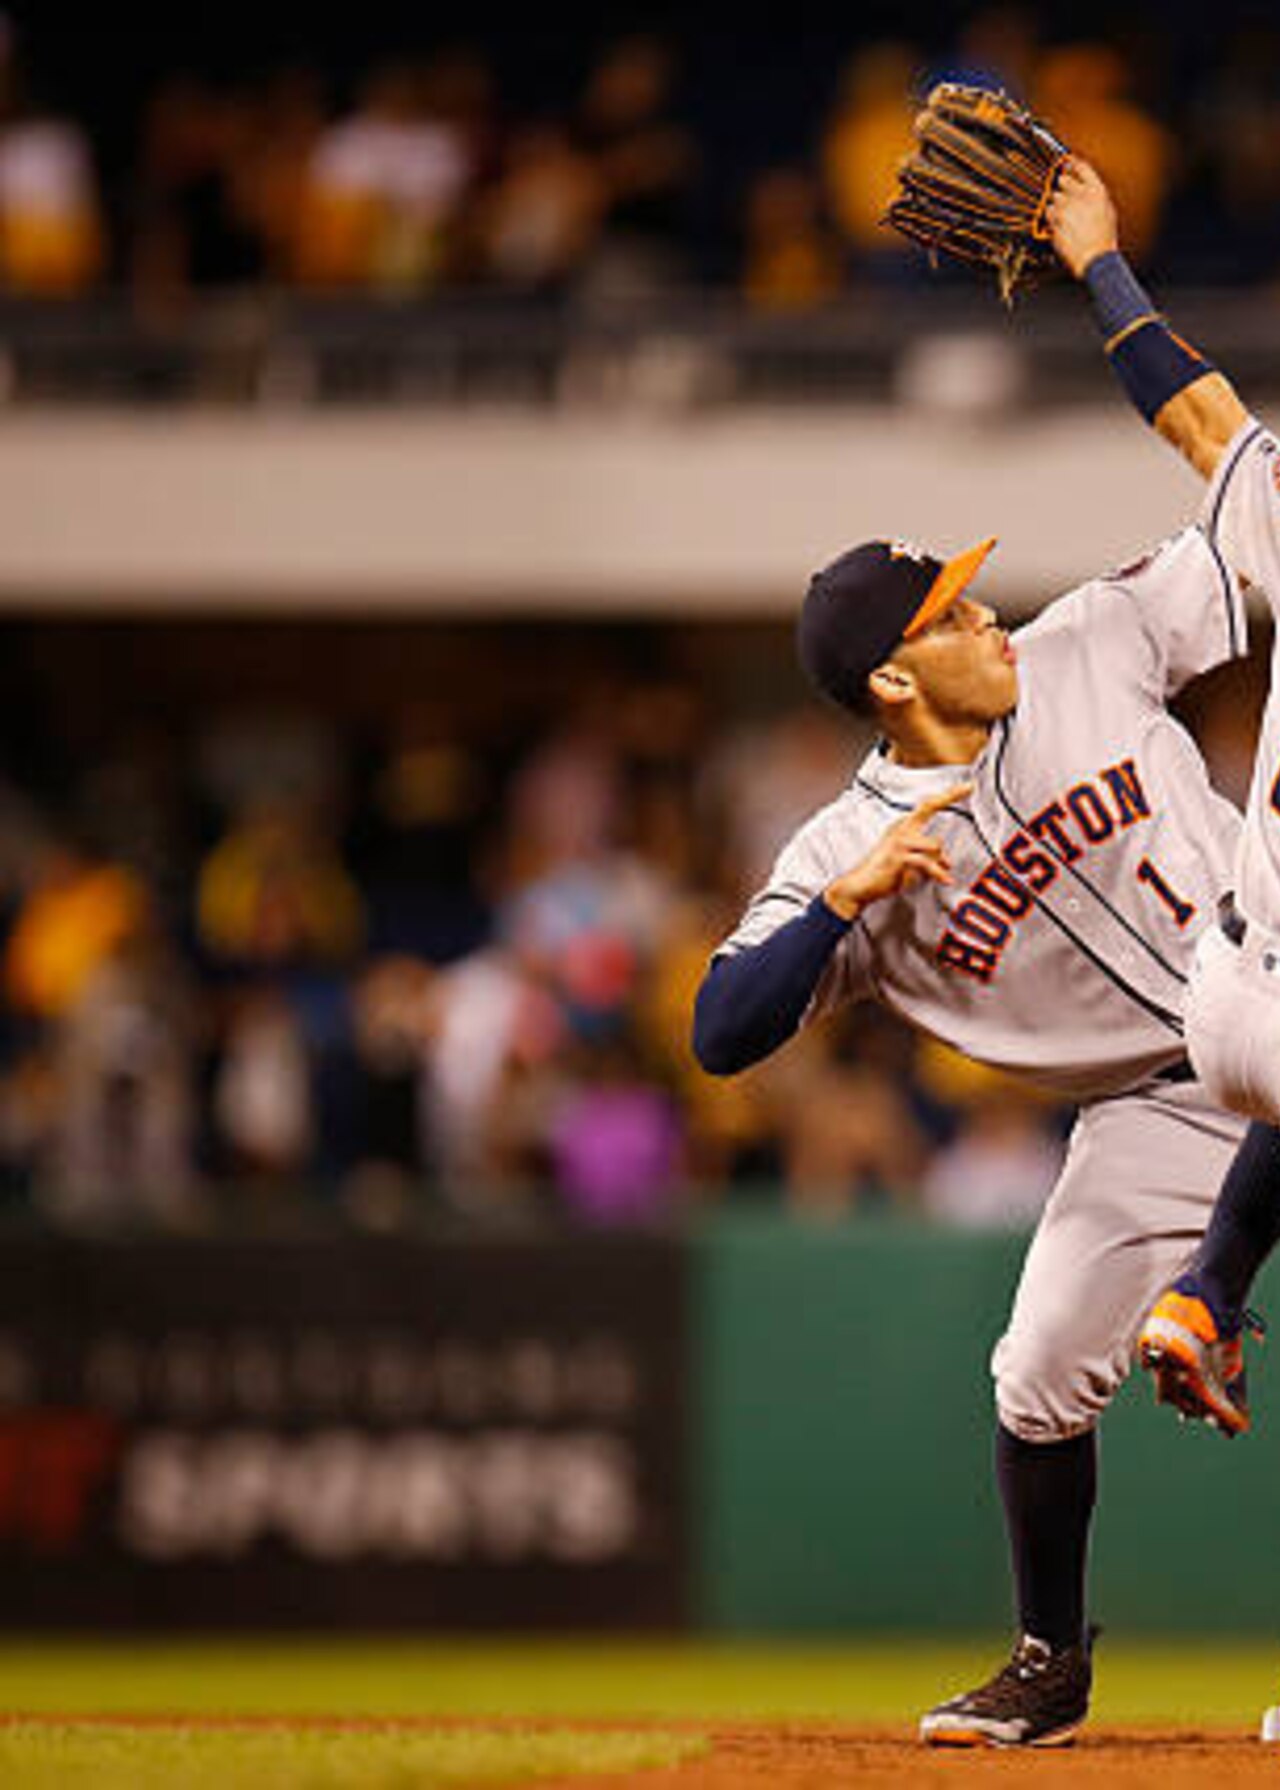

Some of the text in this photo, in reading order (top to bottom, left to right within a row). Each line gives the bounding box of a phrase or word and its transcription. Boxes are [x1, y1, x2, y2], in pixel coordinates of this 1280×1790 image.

[937, 757, 1151, 984] HOUSTON
[1136, 854, 1198, 931] 1
[122, 1430, 636, 1562] SPORTS
